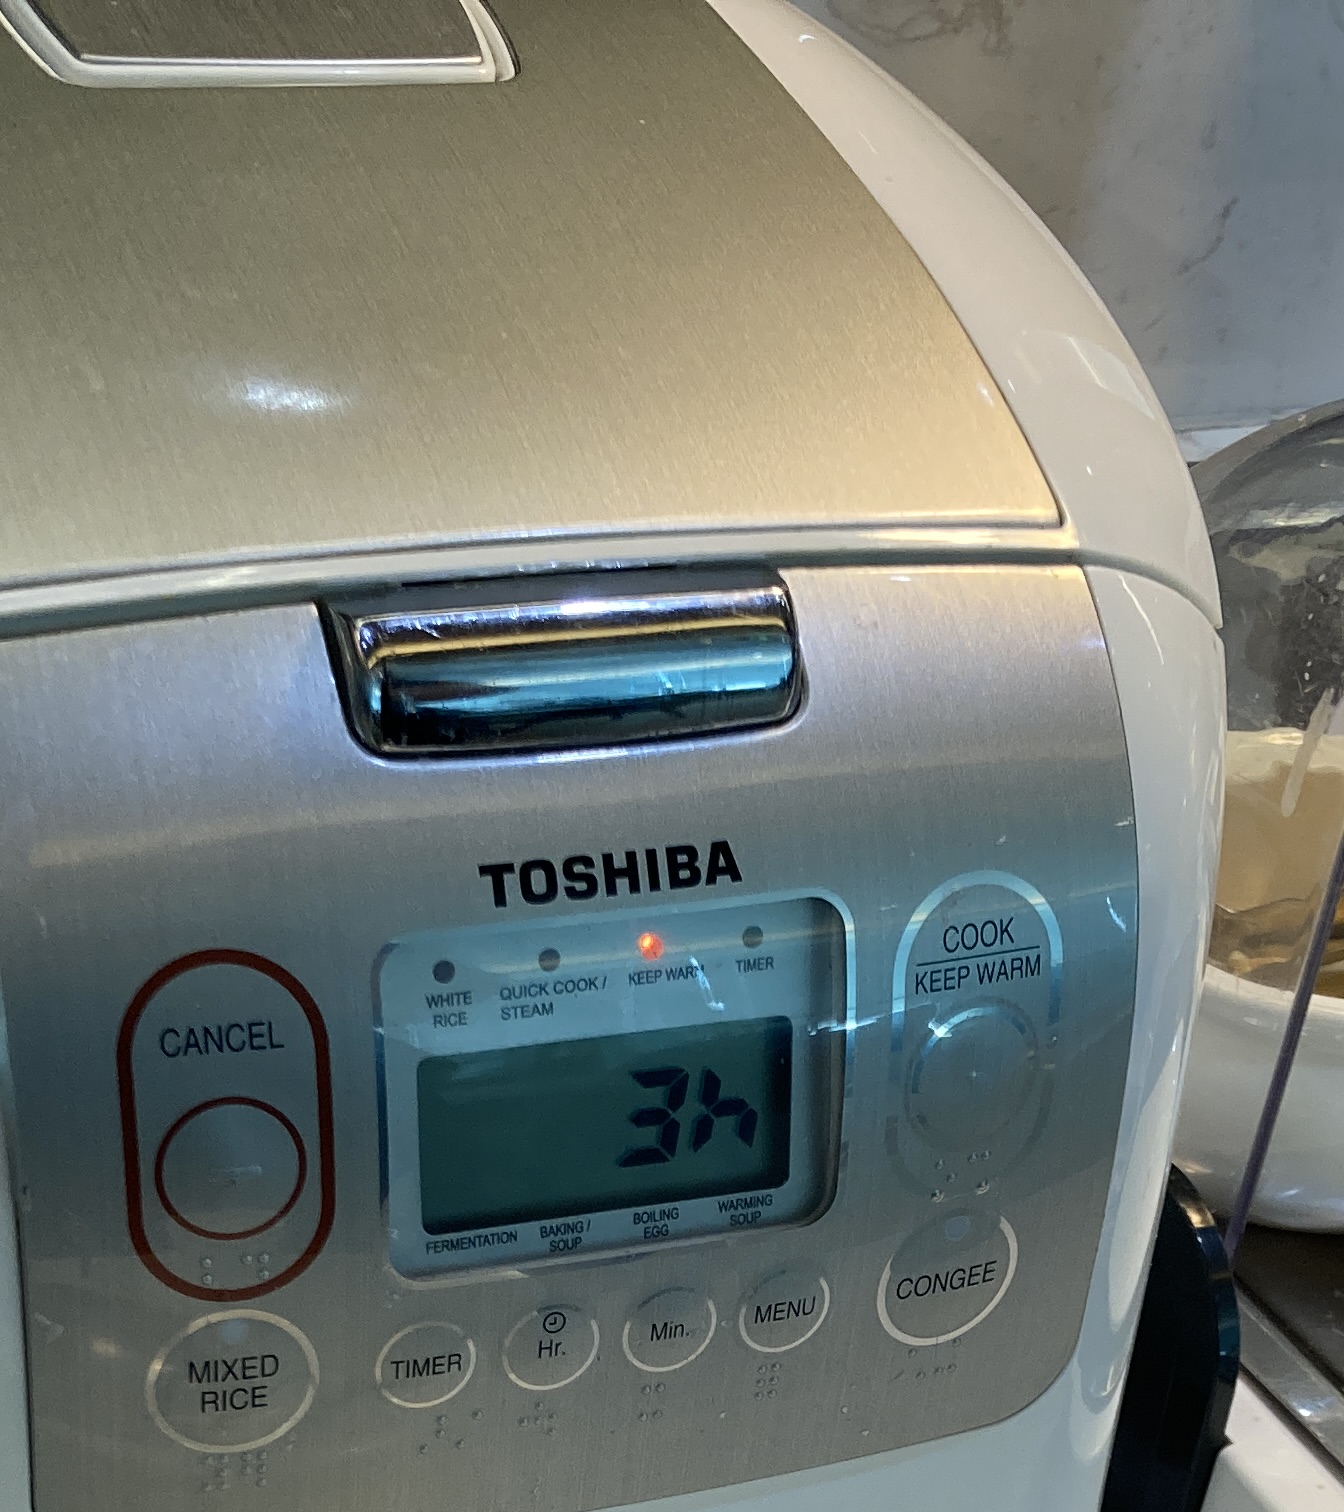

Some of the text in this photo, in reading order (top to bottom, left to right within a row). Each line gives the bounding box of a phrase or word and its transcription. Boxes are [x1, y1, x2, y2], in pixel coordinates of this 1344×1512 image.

[478, 839, 744, 909] TOSHIBA
[942, 917, 1016, 952] COOK
[735, 956, 775, 974] TIMER
[913, 953, 1043, 996] KEEP WARM
[499, 983, 550, 1002] QUICK
[553, 977, 598, 995] COOK
[628, 970, 662, 988] KEEP
[425, 990, 473, 1009] WHITE
[500, 1002, 555, 1021] STEAM
[432, 1012, 468, 1029] RICE
[158, 1021, 286, 1059] CANCEL
[617, 1066, 758, 1168] 3h
[632, 1207, 680, 1226] BOILING
[717, 1194, 774, 1214] WARMING
[729, 1210, 762, 1227] SOUP
[425, 1230, 519, 1255] FERMENTATION
[539, 1223, 585, 1240] BAKING
[642, 1224, 670, 1240] EGG
[549, 1236, 583, 1253] SOUP
[896, 1260, 998, 1301] CONGEE
[754, 1294, 818, 1326] MENU
[650, 1318, 691, 1343] Min.
[537, 1335, 568, 1360] Hr.
[187, 1353, 281, 1385] MIXED
[390, 1353, 463, 1381] TIMER
[199, 1384, 270, 1414] RICE
